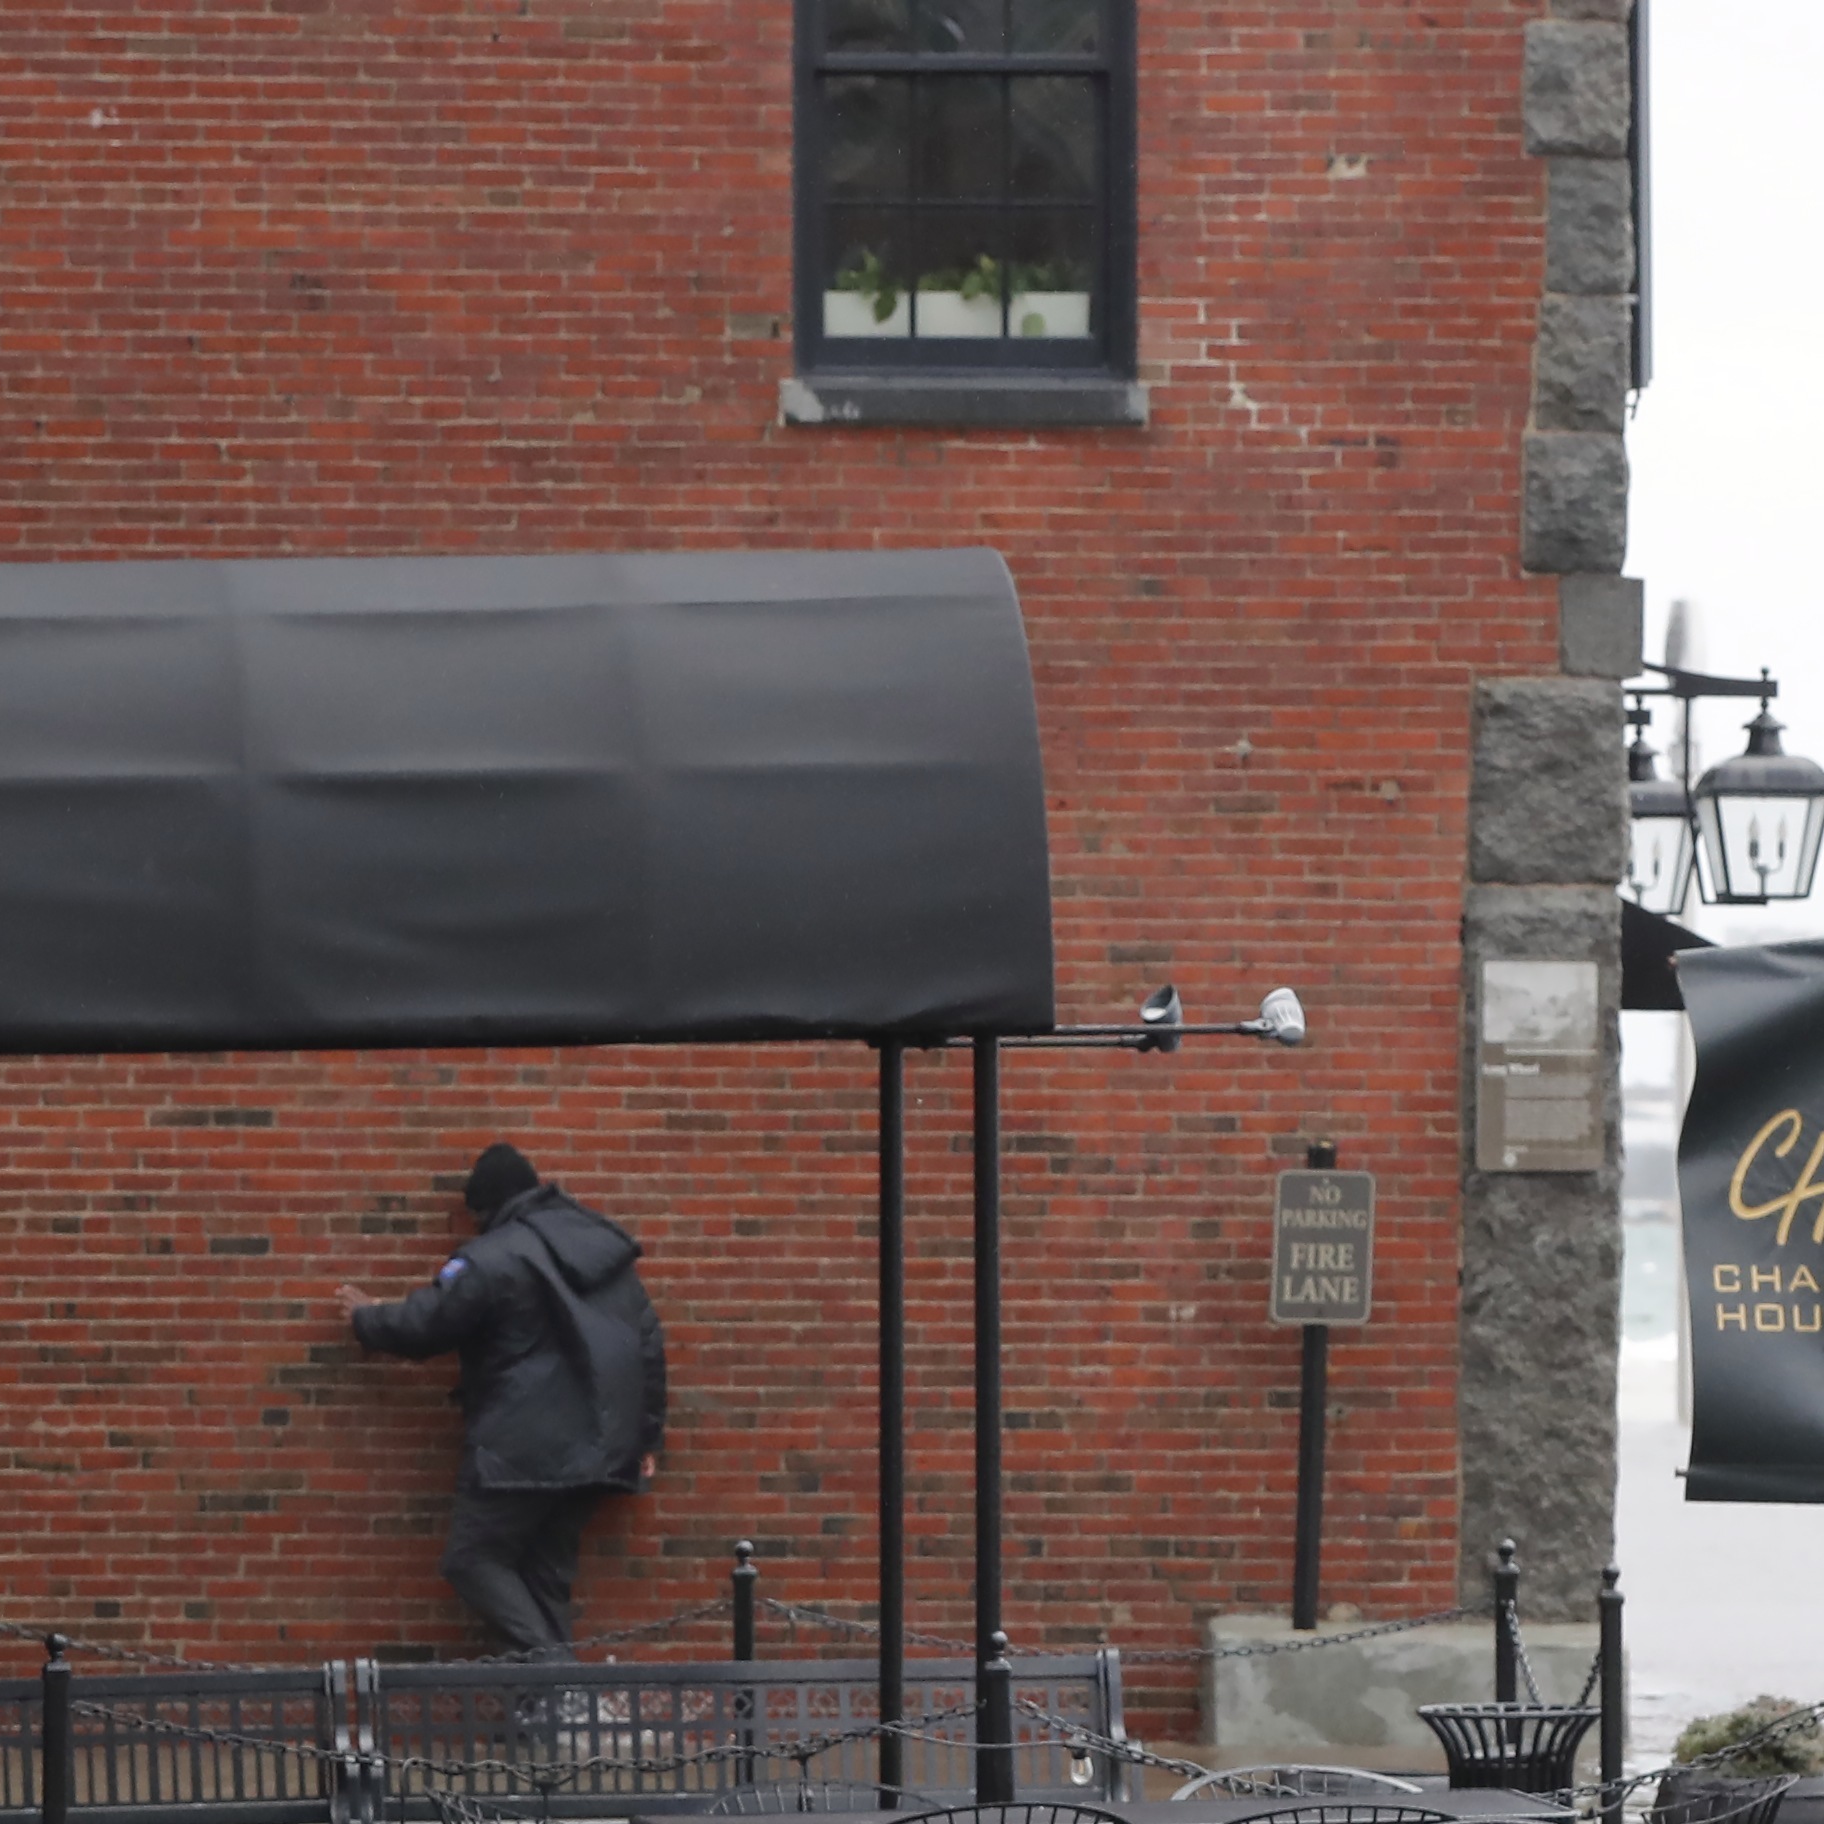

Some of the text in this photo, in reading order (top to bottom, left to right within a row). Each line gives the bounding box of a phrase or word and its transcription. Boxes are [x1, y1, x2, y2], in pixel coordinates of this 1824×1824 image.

[1309, 1184, 1342, 1206] NO
[1281, 1208, 1368, 1230] PARKING
[1290, 1242, 1355, 1271] FIRE
[1282, 1275, 1360, 1303] LANE
